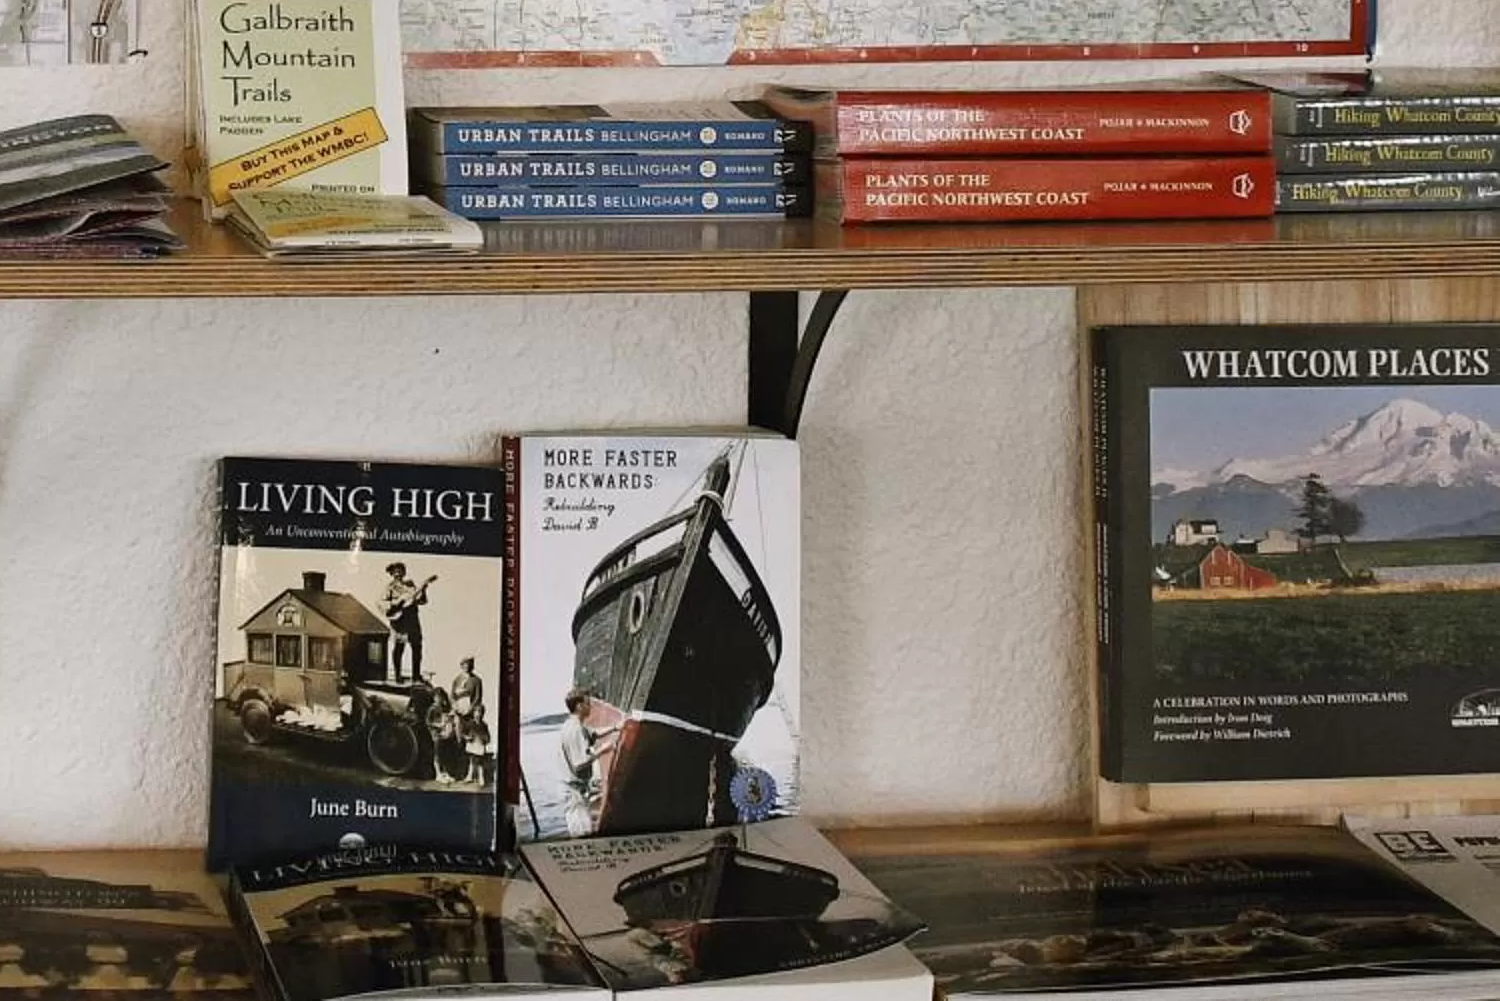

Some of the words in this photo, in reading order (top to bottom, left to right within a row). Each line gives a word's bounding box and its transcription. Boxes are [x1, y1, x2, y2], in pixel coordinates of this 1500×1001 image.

[219, 2, 355, 34] Galbraith
[222, 40, 356, 70] Mountain
[220, 76, 292, 107] Trails
[219, 115, 271, 125] INCLUDES
[273, 115, 302, 124] LAKE
[859, 109, 924, 123] PLANTS
[926, 109, 951, 122] OF
[954, 109, 985, 122] THE
[1144, 118, 1210, 128] MACKINNON
[1335, 109, 1381, 127] Hiking
[1385, 107, 1451, 122] Whatcom
[1455, 107, 1500, 126] County
[458, 128, 522, 143] URBAN
[528, 128, 596, 143] TRAILS
[600, 130, 691, 143] BELLINGHAM
[860, 127, 923, 142] PACIFIC
[925, 127, 1028, 141] NORTHWEST
[1031, 127, 1085, 141] COAST
[240, 155, 269, 172] BUY
[268, 141, 300, 164] THIS
[301, 129, 331, 149] MAP
[333, 126, 344, 137] &
[1324, 146, 1371, 165] Hiking
[1377, 145, 1444, 161] Whatcom
[1446, 145, 1494, 162] County
[228, 163, 288, 190] SUPPORT
[290, 153, 316, 170] THE
[317, 132, 370, 159] WMBC!
[459, 162, 523, 176] URBAN
[530, 161, 596, 176] TRAILS
[601, 164, 692, 176] BELLINGHAM
[311, 184, 357, 192] PRINTED
[359, 185, 375, 193] ON
[866, 174, 929, 187] PLANTS
[933, 174, 956, 187] OF
[960, 174, 990, 187] THE
[1149, 181, 1213, 192] MACKINNON
[461, 194, 525, 208] URBAN
[531, 193, 597, 208] TRAILS
[603, 195, 693, 208] BELLINGHAM
[866, 192, 929, 206] PACIFIC
[932, 192, 1032, 206] NORTHWEST
[1035, 191, 1089, 205] COAST
[1292, 184, 1339, 204] Hiking
[1345, 182, 1411, 198] Whatcom
[1414, 183, 1463, 200] County
[1182, 350, 1360, 379] WHATCOM
[1368, 349, 1490, 377] PLACES
[544, 450, 593, 467] MORE
[605, 450, 677, 467] FASTER
[237, 481, 375, 516] LIVING
[391, 487, 493, 521] HIGH
[265, 523, 283, 536] An
[380, 527, 465, 547] Autobiography
[1153, 698, 1161, 708] A
[1163, 697, 1242, 708] CELEBRATION
[1244, 696, 1256, 707] IN
[1258, 695, 1299, 707] WORDS
[1301, 694, 1325, 705] AND
[1327, 692, 1409, 704] PHOTOGRAPHS
[1213, 730, 1251, 740] William
[309, 798, 349, 819] June
[355, 799, 399, 819] Burn
